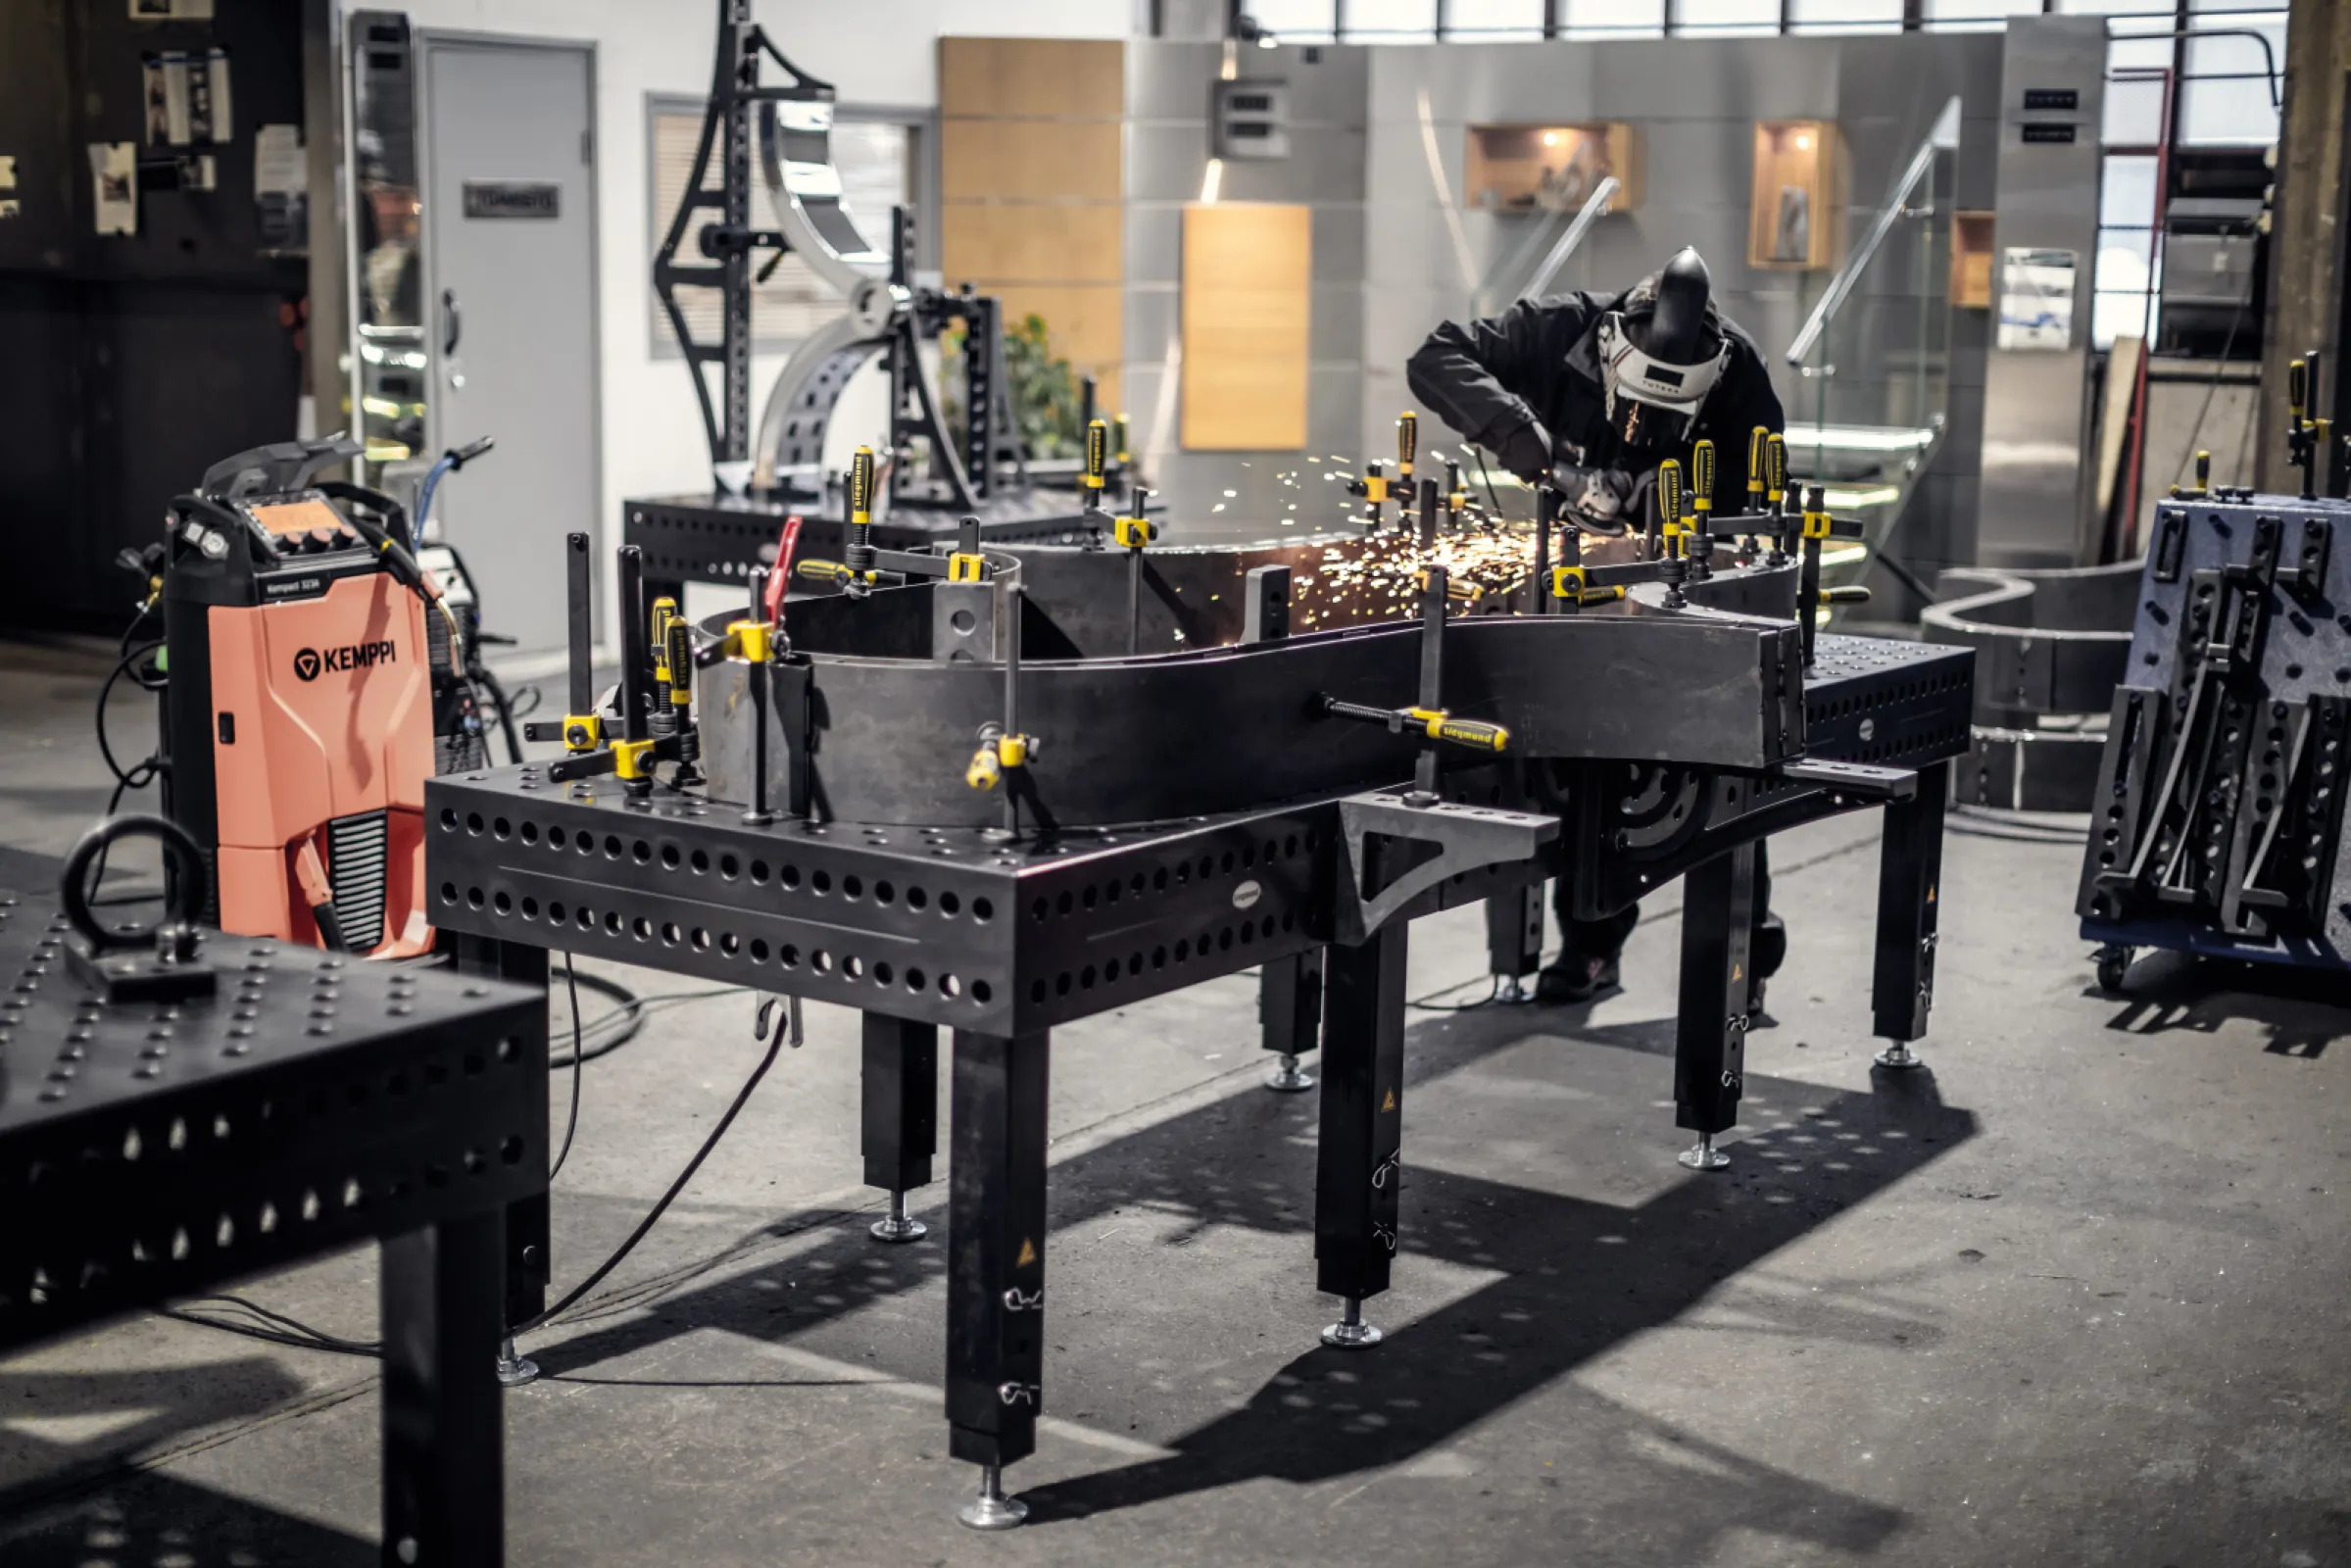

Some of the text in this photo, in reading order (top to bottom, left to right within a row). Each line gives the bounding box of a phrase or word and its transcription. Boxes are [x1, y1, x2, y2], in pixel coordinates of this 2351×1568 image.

[854, 456, 863, 507] siegmund
[1670, 469, 1679, 518] siegmund
[323, 639, 396, 673] KEMPPI
[1444, 726, 1492, 743] siegmund
